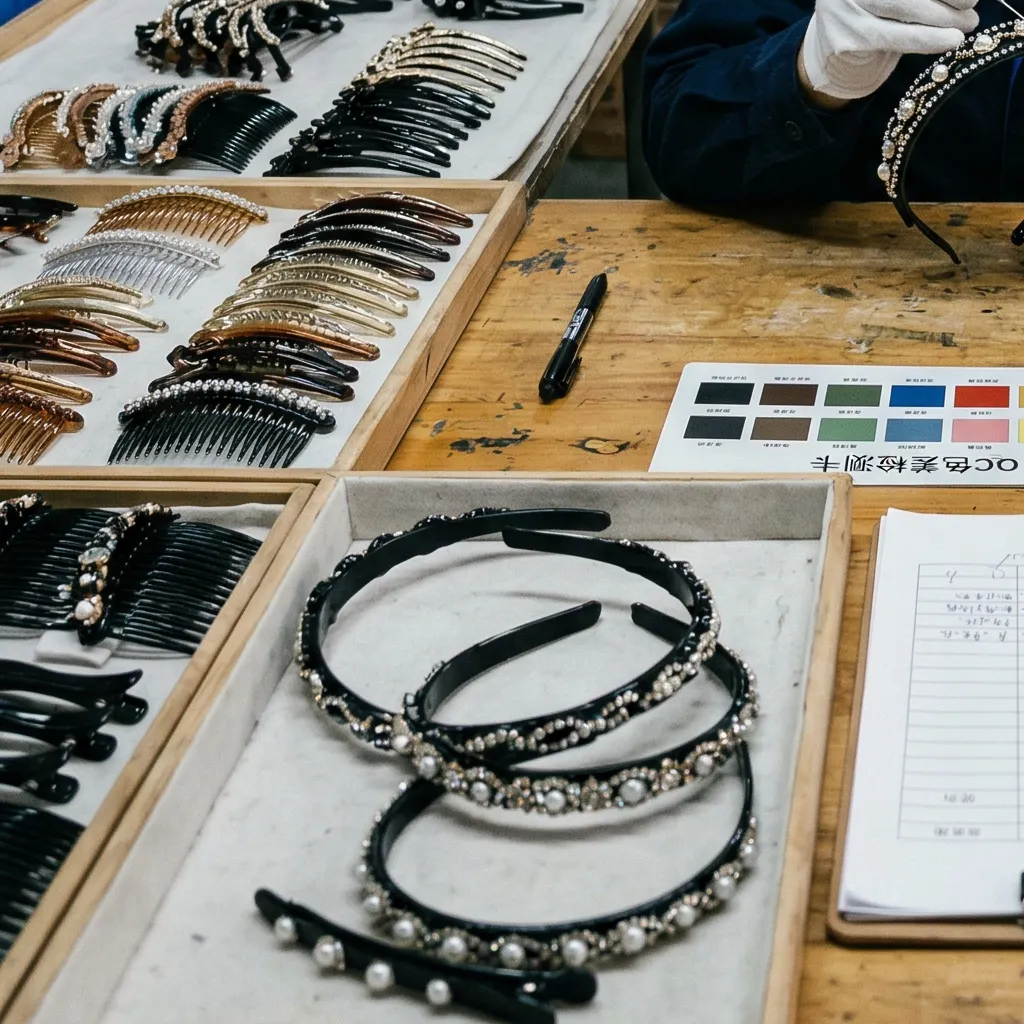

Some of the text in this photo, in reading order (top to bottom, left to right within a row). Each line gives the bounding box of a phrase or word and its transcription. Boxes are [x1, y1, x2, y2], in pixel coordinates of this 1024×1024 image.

[810, 454, 1019, 473] QC色差检测卡
